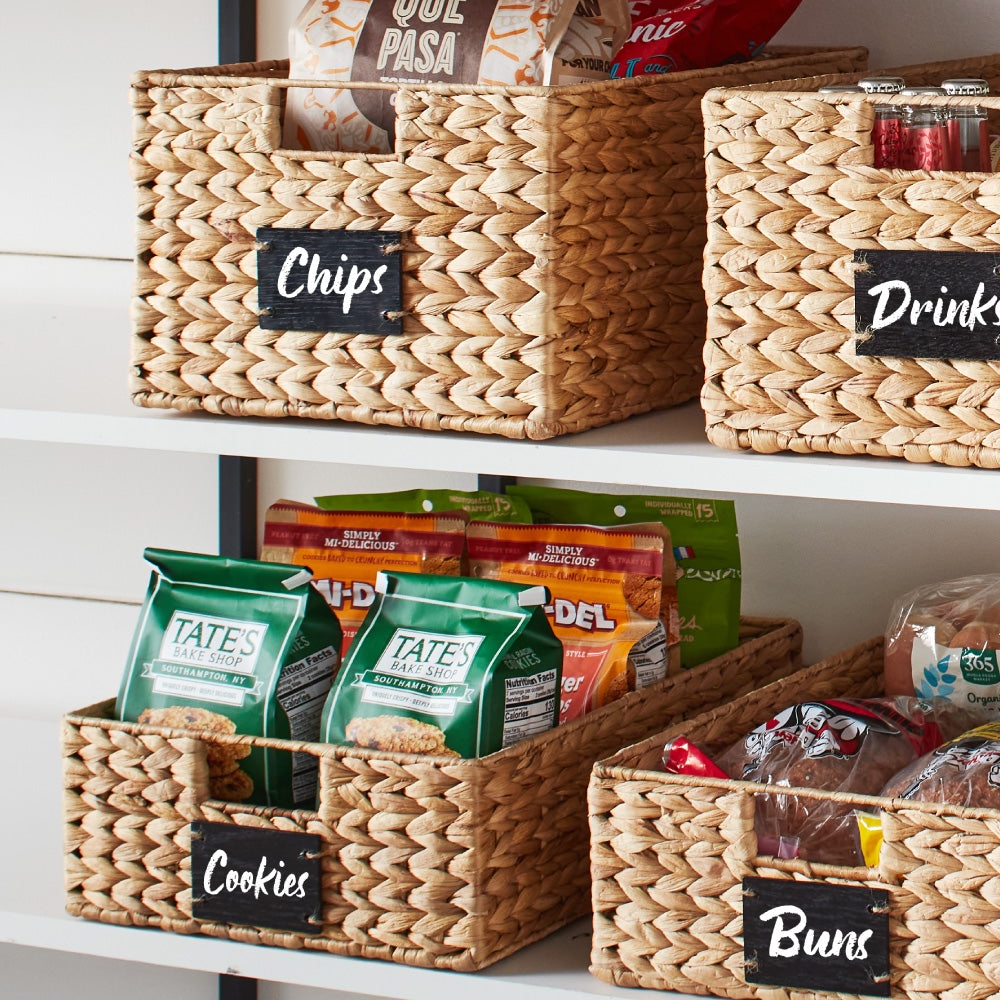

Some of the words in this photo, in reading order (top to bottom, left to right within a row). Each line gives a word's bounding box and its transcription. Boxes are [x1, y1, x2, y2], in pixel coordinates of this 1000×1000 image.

[376, 27, 457, 76] PASA
[584, 57, 606, 72] YOUR
[277, 246, 388, 315] Chips
[494, 497, 511, 511] 15
[644, 499, 692, 511] INDIVIDUALLY
[695, 502, 714, 519] 15
[660, 508, 694, 518] WRAPPED
[343, 529, 382, 541] SIMPLY
[545, 544, 584, 556] SIMPLY
[172, 617, 260, 657] TATE'S
[172, 646, 206, 662] BAKE
[208, 652, 243, 667] SHOP
[305, 648, 333, 666] Facts
[391, 635, 475, 668] TATE'S
[565, 649, 586, 658] STYLE
[391, 660, 424, 674] BAKE
[425, 665, 458, 680] SHOP
[963, 656, 995, 673] 365
[231, 676, 247, 686] NY
[505, 677, 538, 689] Nutrition
[537, 671, 555, 683] Facts
[446, 686, 459, 695] NY
[281, 692, 311, 709] Calories
[505, 709, 529, 721] Calories
[203, 848, 310, 900] Cookies
[758, 904, 874, 961] Buns
